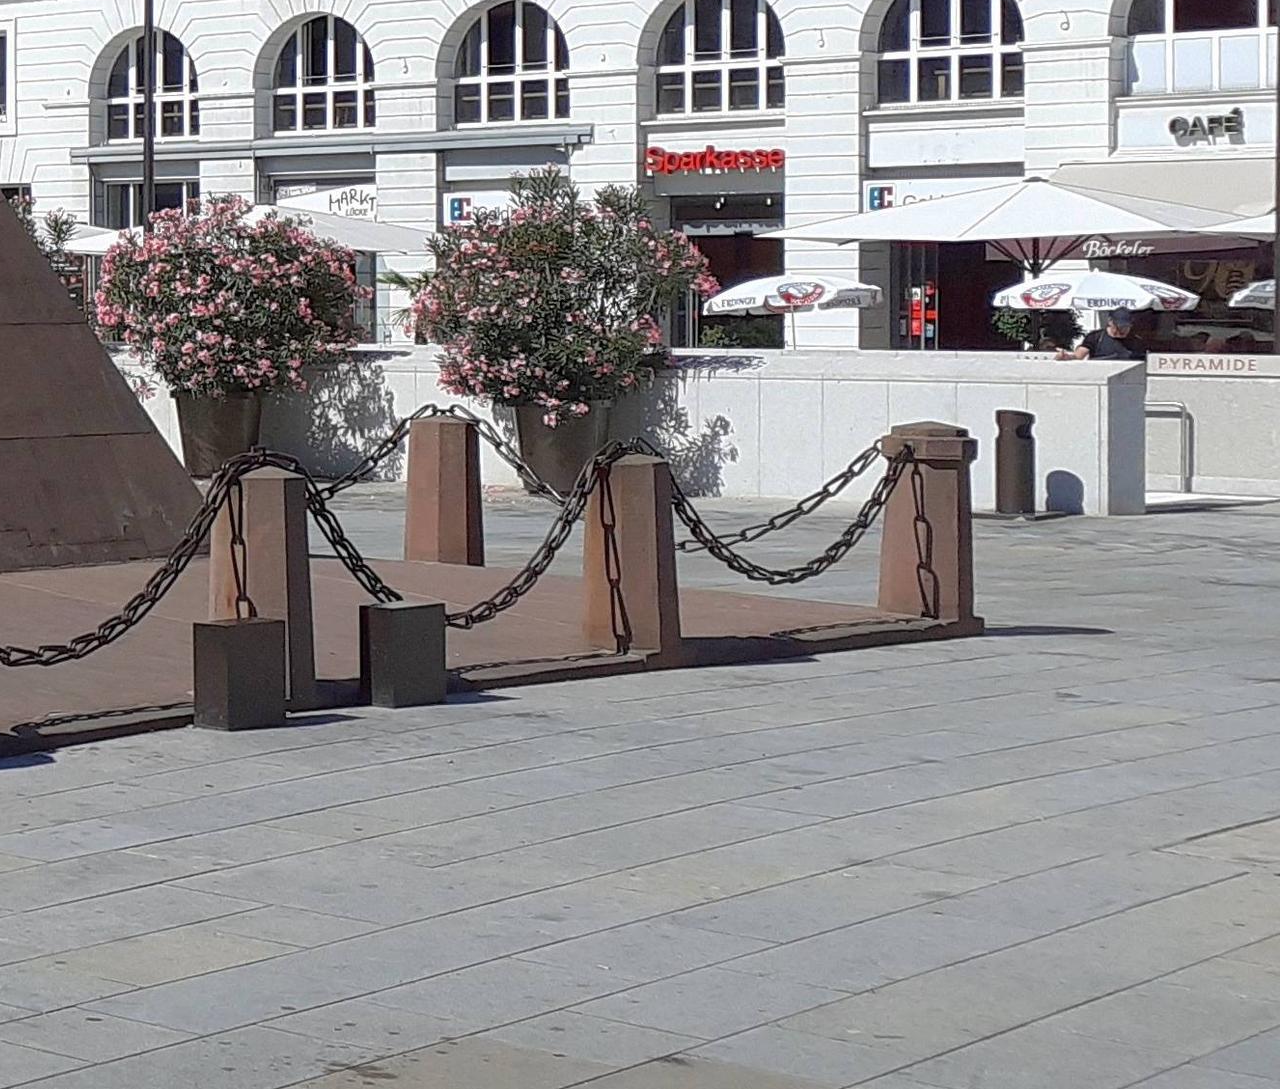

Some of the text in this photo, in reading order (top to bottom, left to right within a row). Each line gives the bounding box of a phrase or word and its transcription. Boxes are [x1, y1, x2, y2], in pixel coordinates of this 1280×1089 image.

[644, 145, 786, 175] Sparkasse
[328, 188, 377, 212] MARKT
[1082, 240, 1155, 259] Böckeler
[1157, 357, 1257, 372] PYRAMIDE
